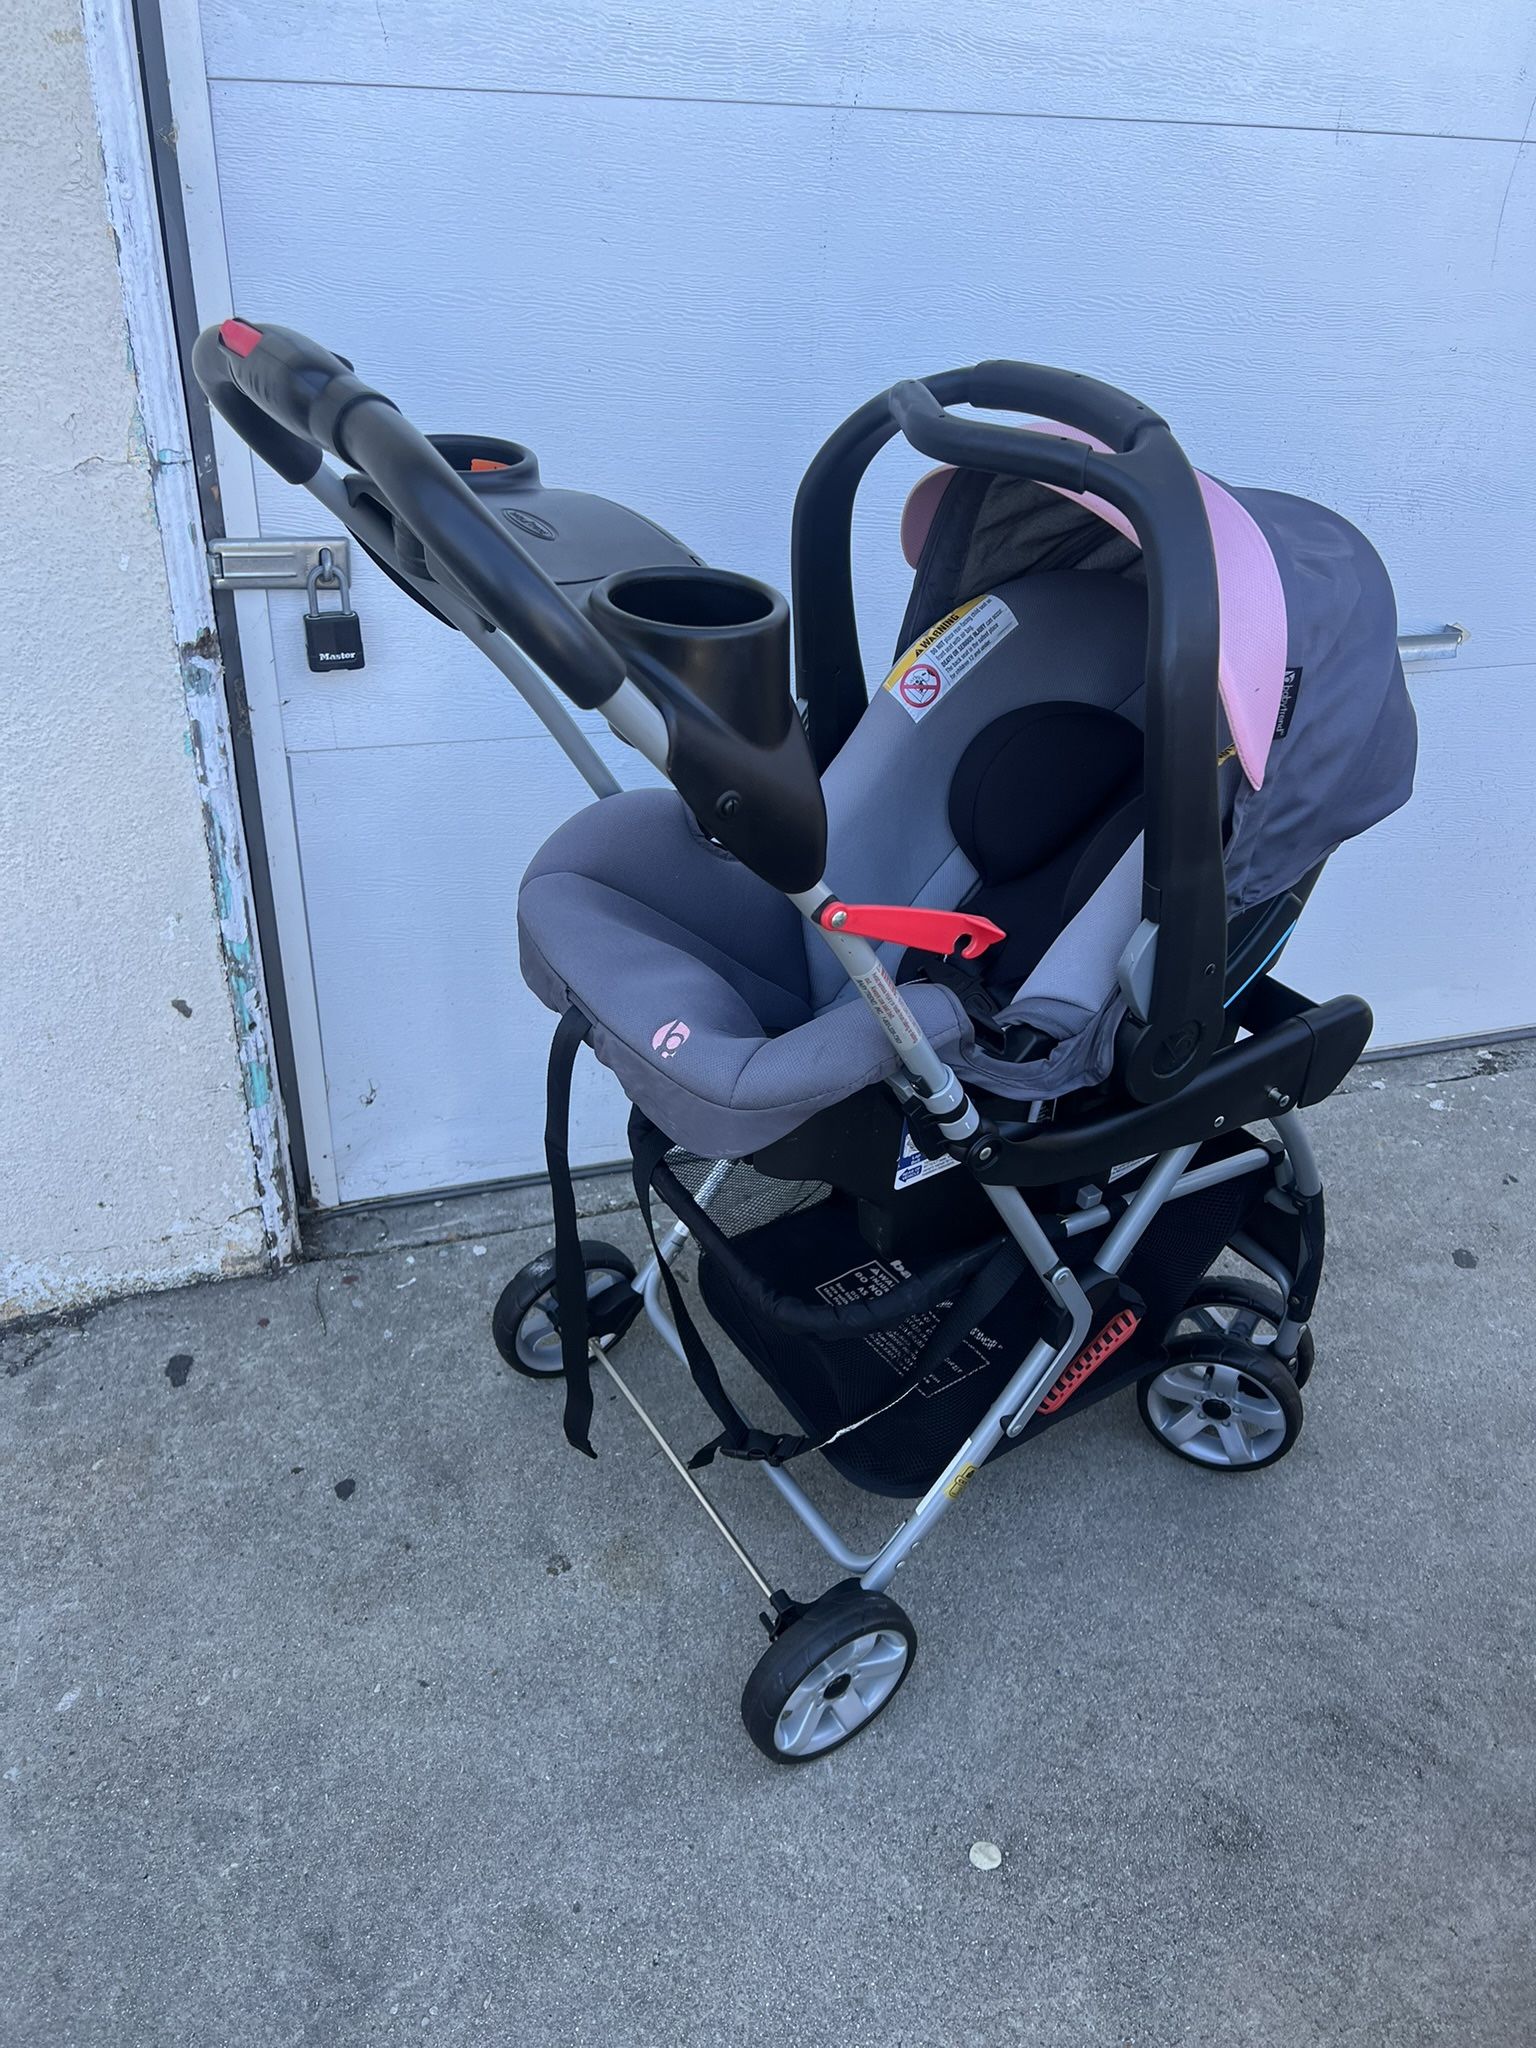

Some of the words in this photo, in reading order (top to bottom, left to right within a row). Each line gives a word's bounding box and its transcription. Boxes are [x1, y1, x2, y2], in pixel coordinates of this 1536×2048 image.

[920, 614, 960, 650] WARNING
[319, 652, 356, 661] Master
[854, 1272, 868, 1283] DO
